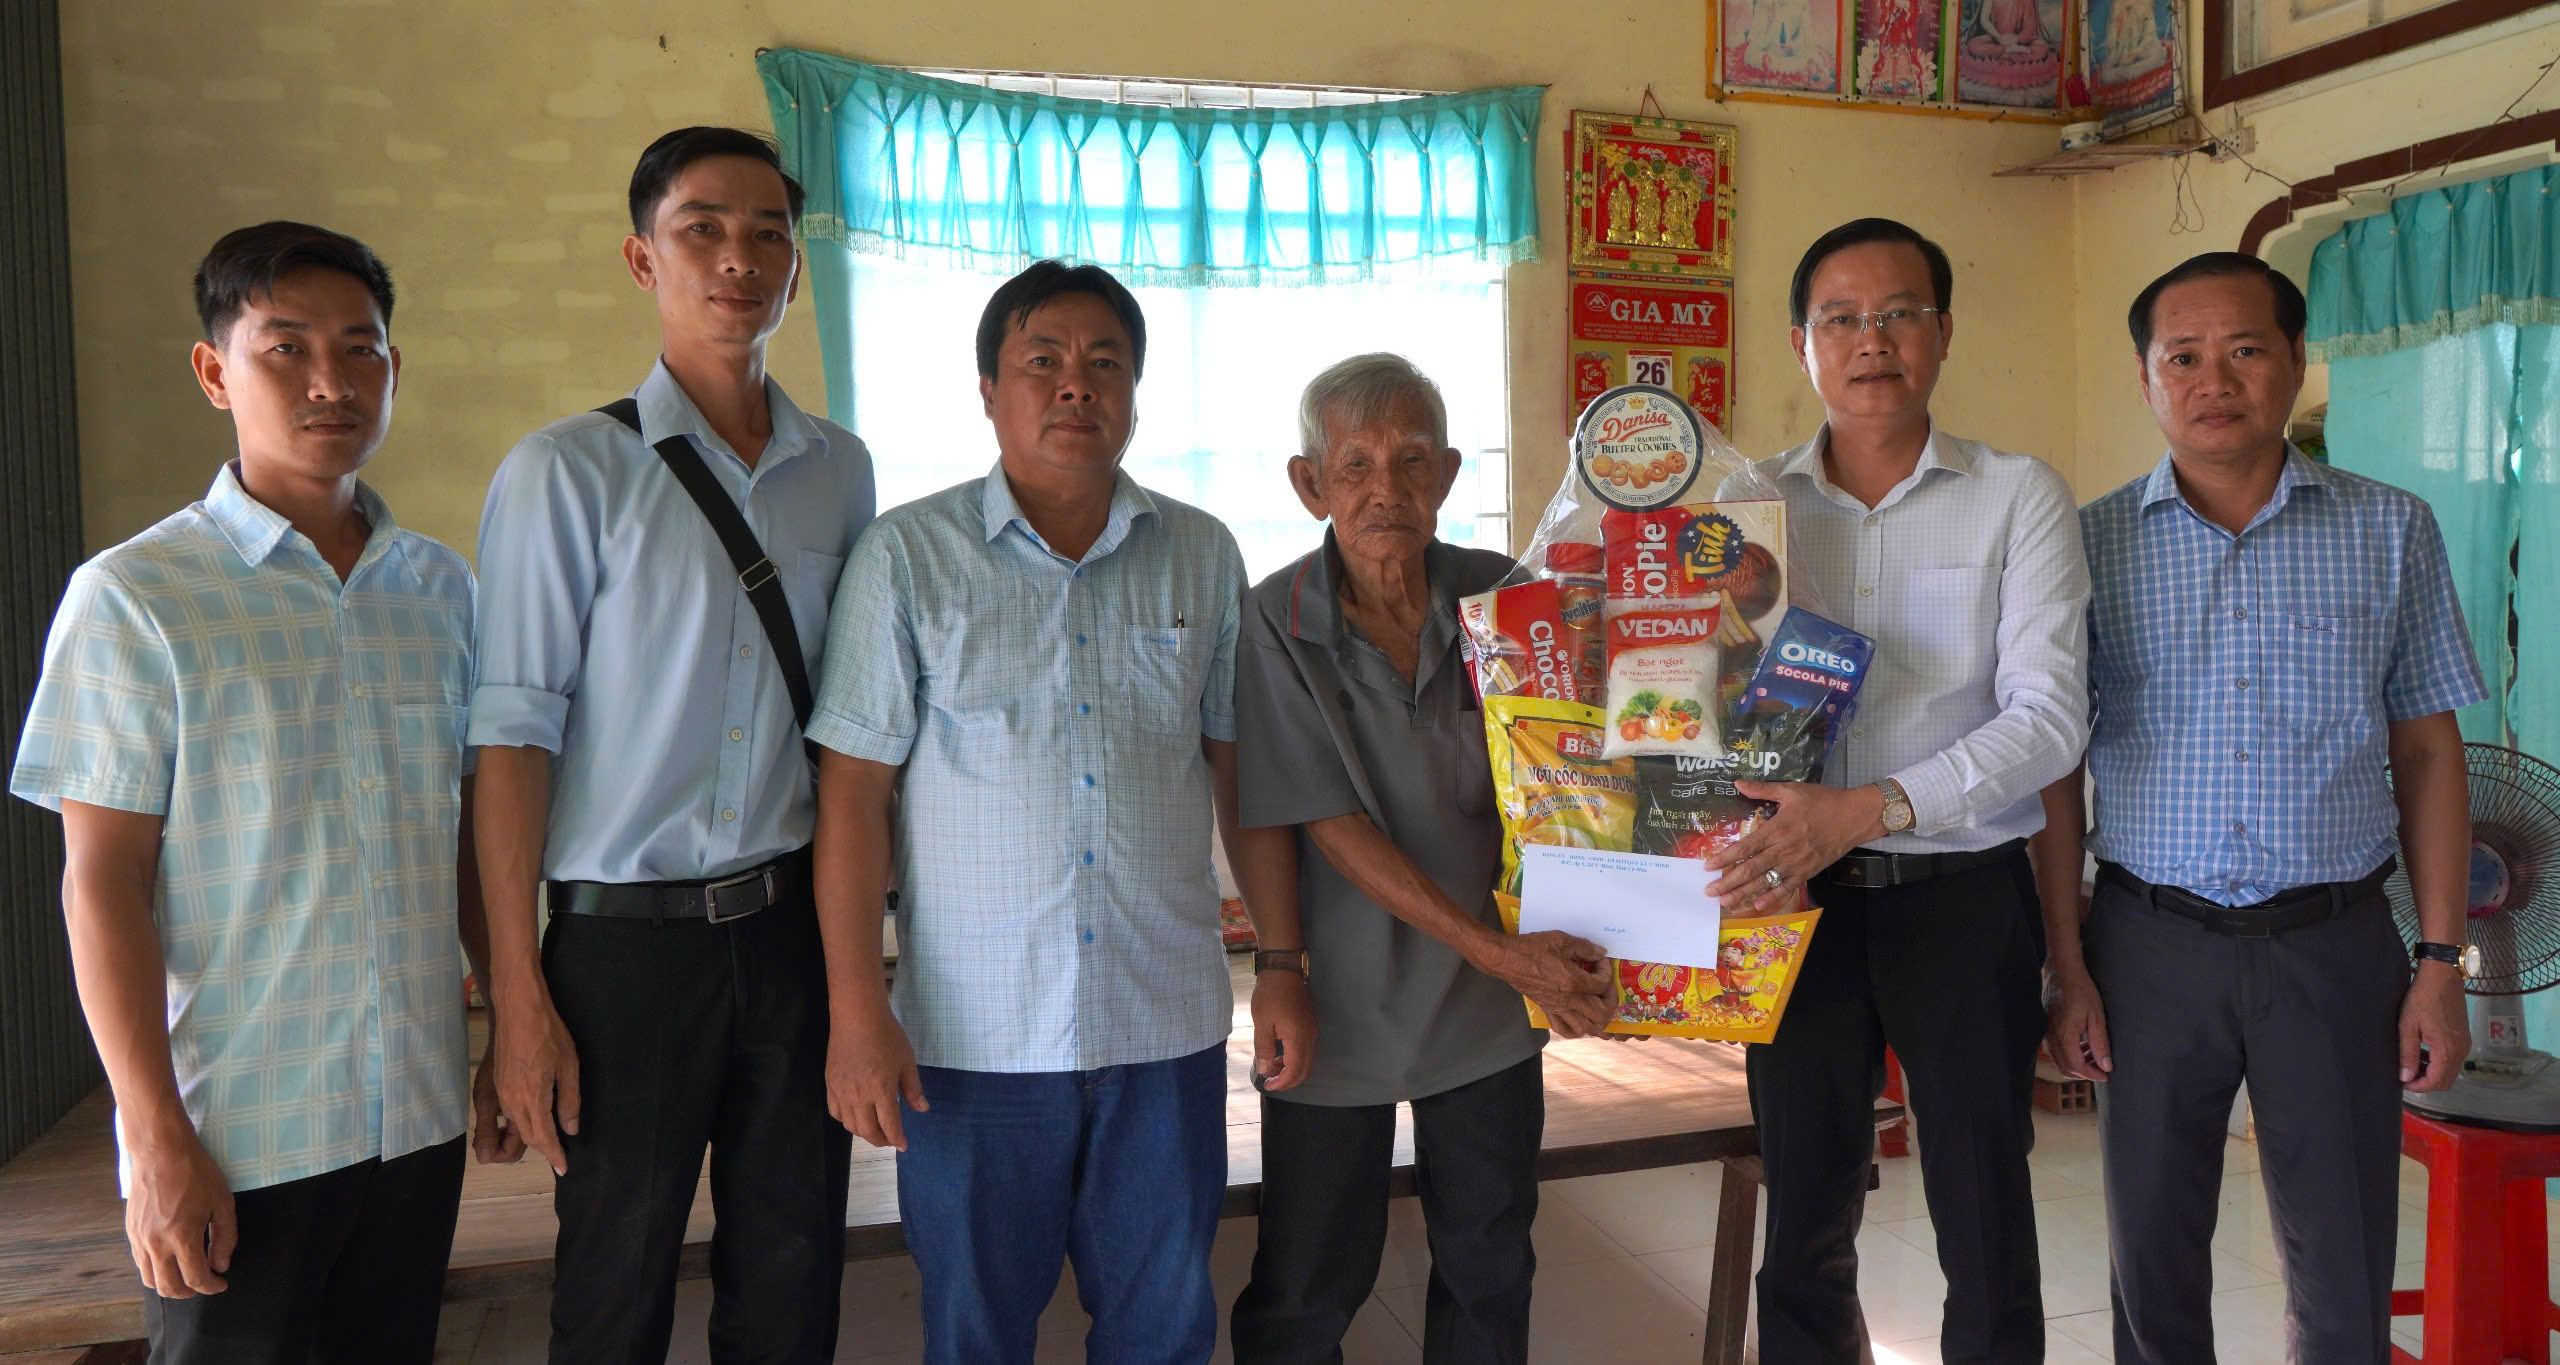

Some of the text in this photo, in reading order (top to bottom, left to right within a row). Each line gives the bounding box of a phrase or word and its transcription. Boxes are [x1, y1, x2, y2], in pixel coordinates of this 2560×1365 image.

[1610, 298, 1664, 323] GIA
[1636, 361, 1665, 386] 26
[1598, 408, 1672, 444] Danisa
[1601, 442, 1677, 454] BUTTER COOKIES
[1634, 435, 1673, 443] TRADITIONAL
[1622, 566, 1636, 597] ION
[1616, 618, 1708, 638] VEDAN
[1780, 643, 1855, 673] OREO
[1776, 665, 1849, 692] SOCOLA PIE
[1554, 762, 1578, 787] CỐC
[1671, 783, 1708, 798] café
